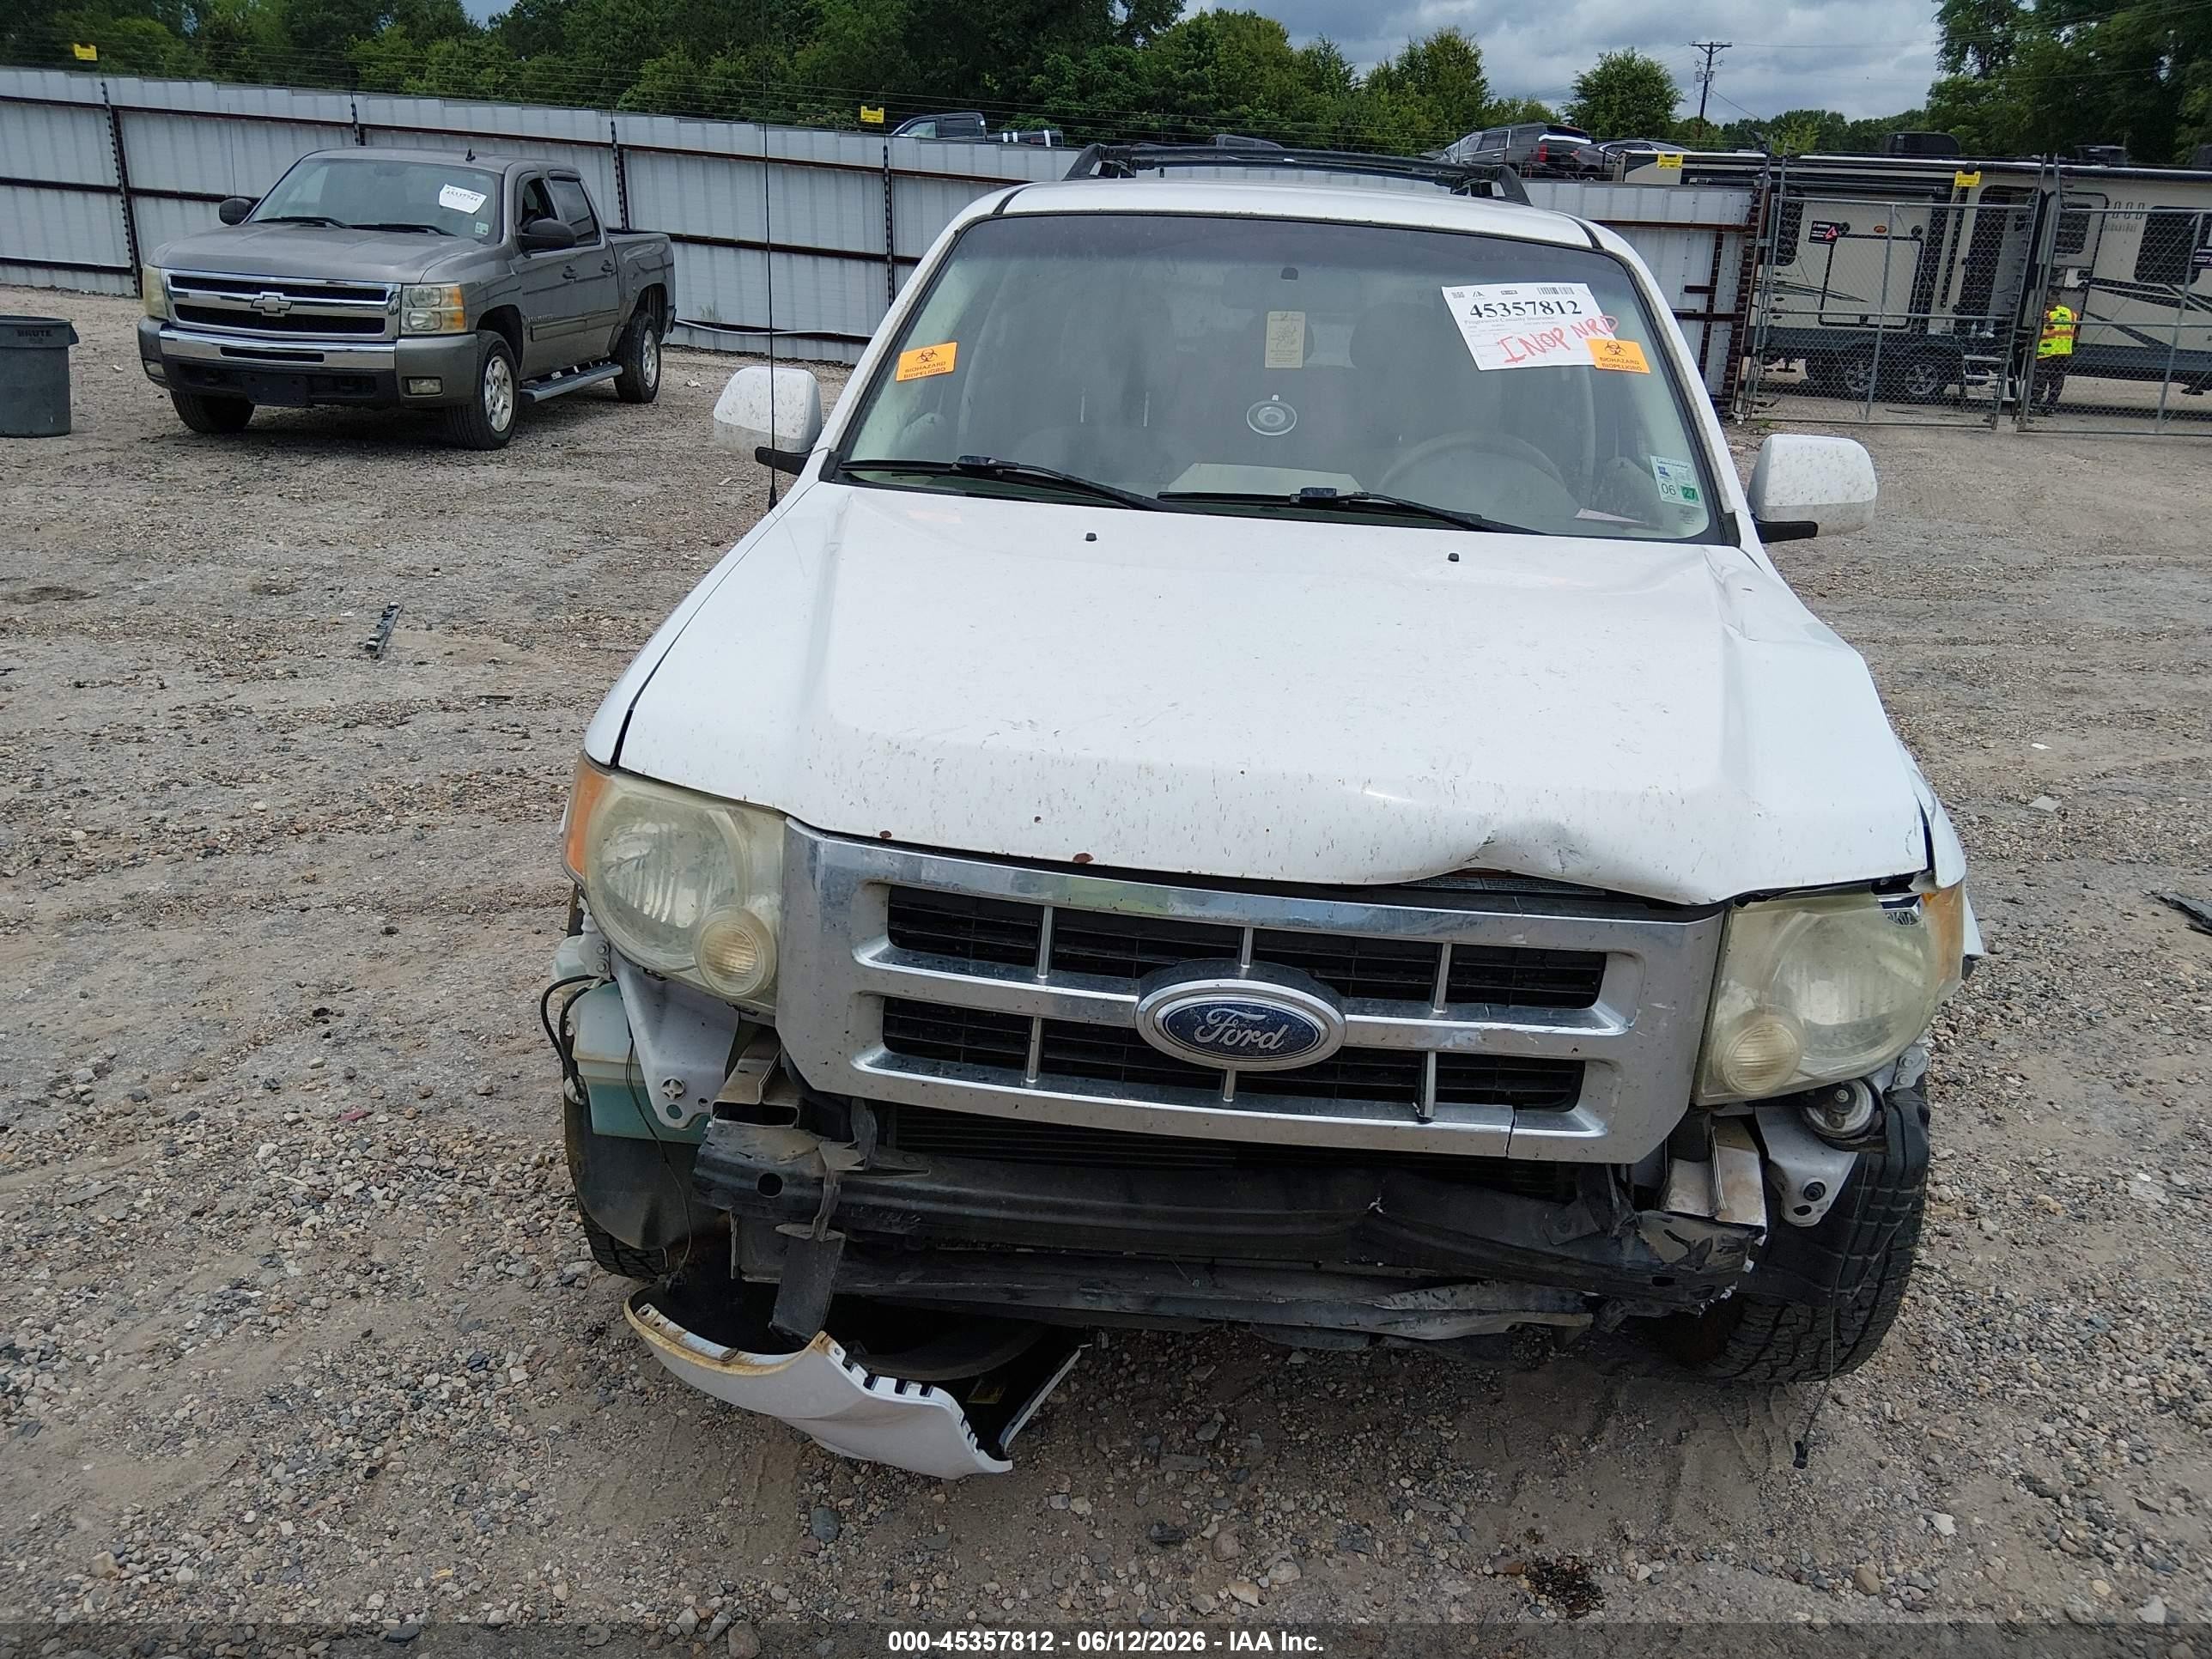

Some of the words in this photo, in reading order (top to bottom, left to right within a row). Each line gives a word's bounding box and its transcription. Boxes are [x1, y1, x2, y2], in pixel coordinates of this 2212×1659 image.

[1470, 301, 1582, 318] 45357812
[1498, 327, 1571, 363] INOP
[905, 362, 945, 373] BIOHAZARD
[1600, 356, 1640, 365] BIOHAZARD
[1661, 483, 1676, 495] 06
[1194, 1007, 1289, 1050] Ford
